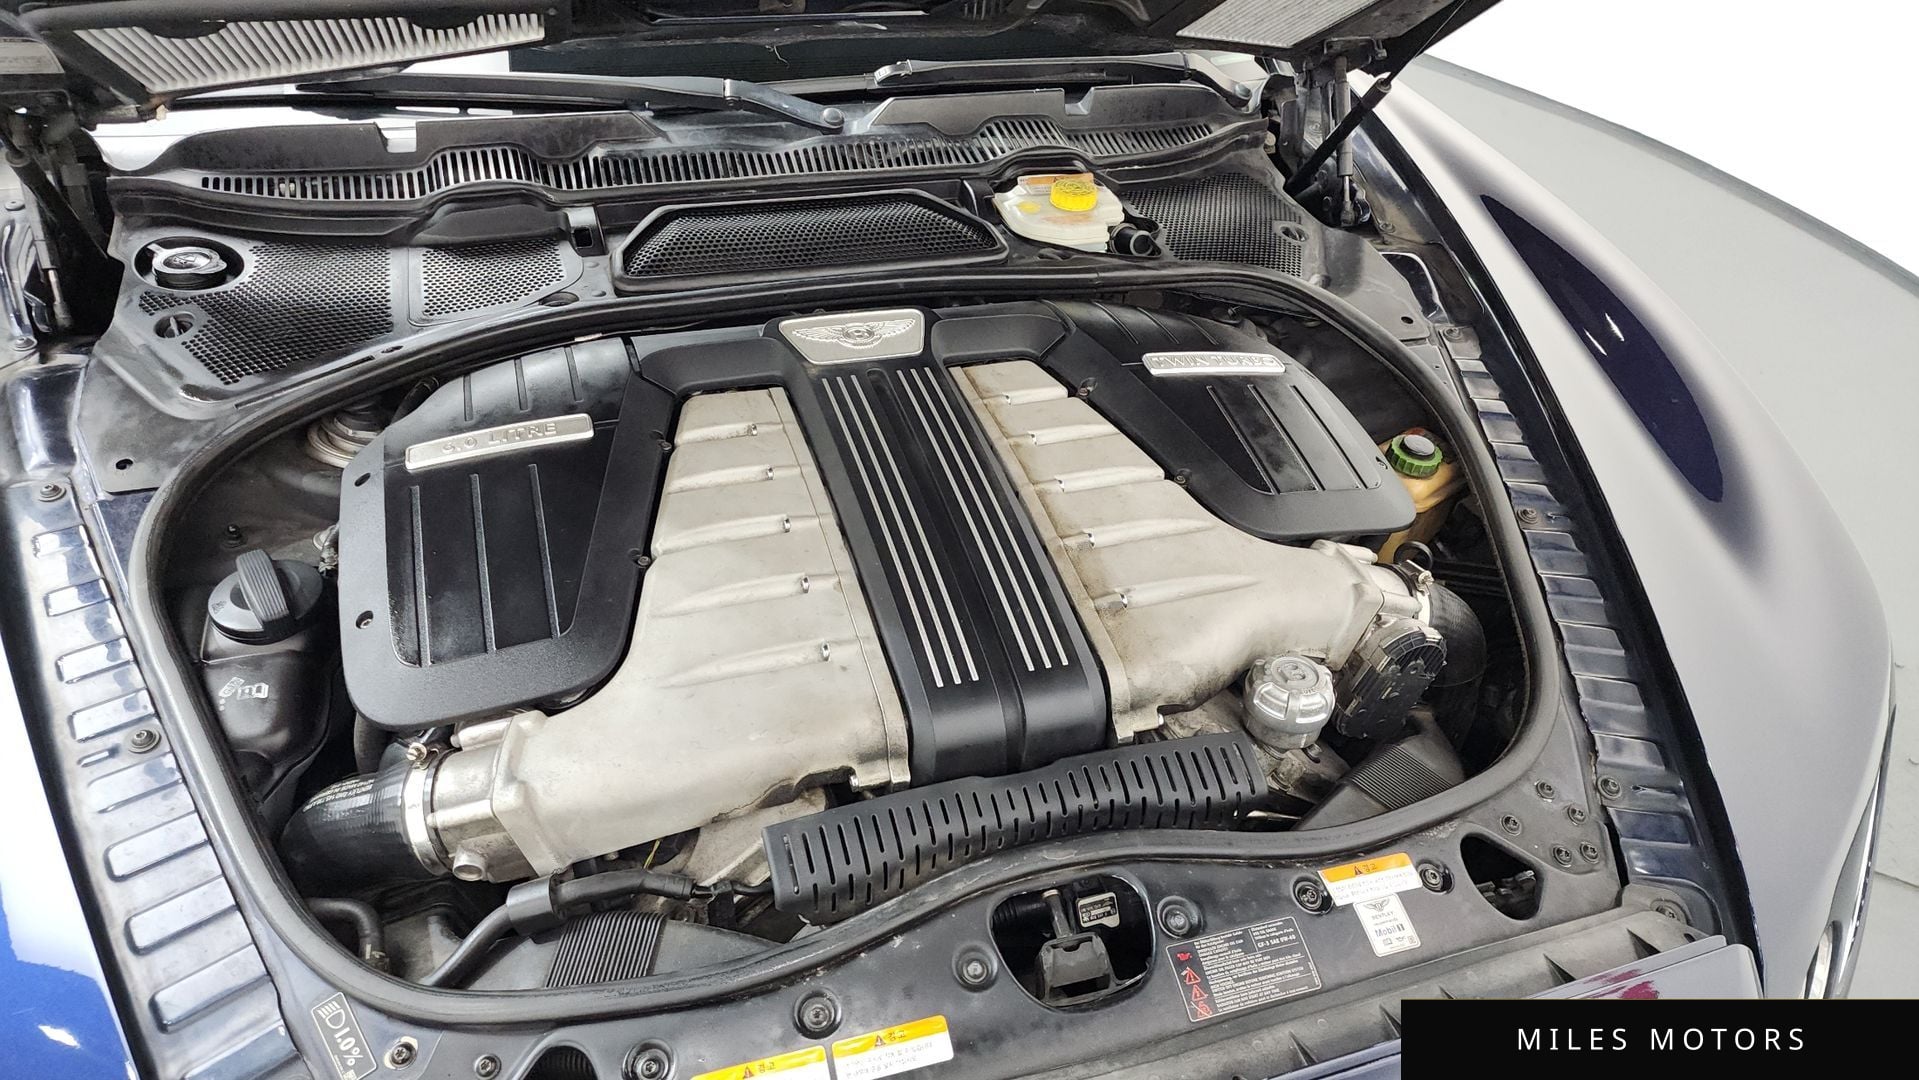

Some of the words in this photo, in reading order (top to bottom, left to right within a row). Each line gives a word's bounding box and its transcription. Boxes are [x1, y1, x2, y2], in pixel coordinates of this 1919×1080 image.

[1151, 357, 1209, 367] TWIN
[1211, 356, 1277, 367] TURBO
[488, 423, 557, 445] LITRE
[1374, 925, 1397, 937] Mobil
[334, 1027, 364, 1066] 1.0%
